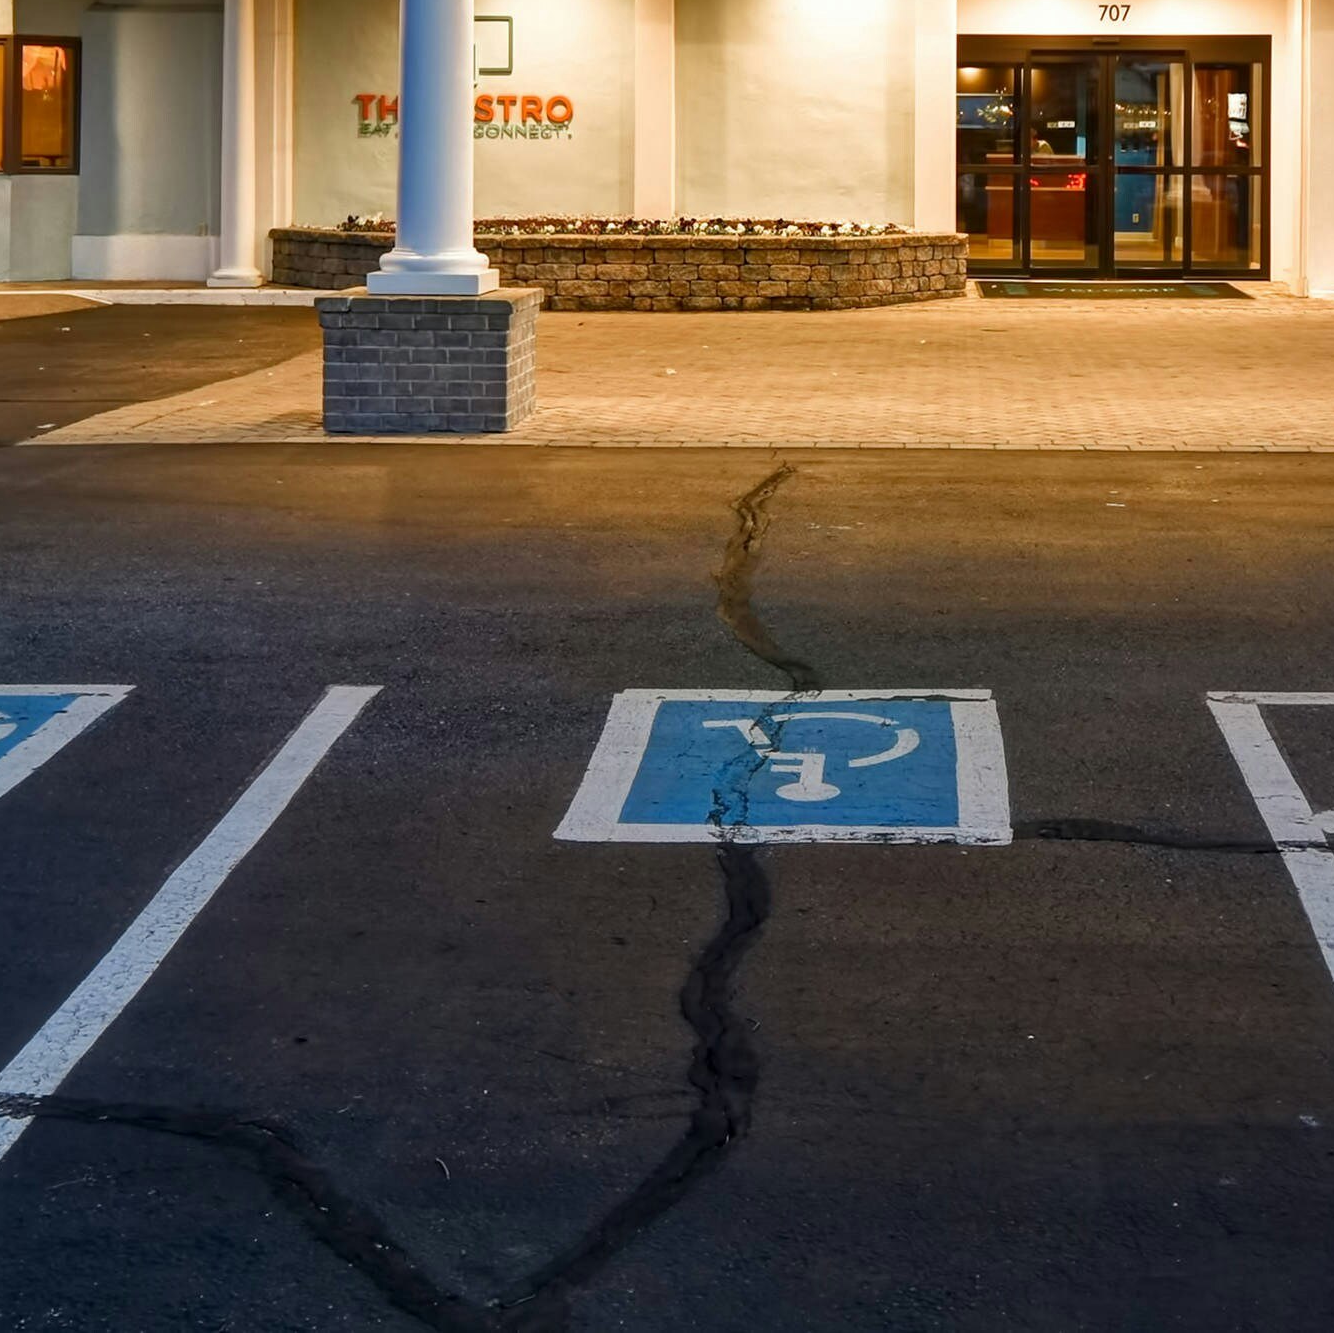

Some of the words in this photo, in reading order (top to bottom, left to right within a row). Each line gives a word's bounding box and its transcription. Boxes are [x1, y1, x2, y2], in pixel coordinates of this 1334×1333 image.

[1098, 4, 1131, 21] 707
[353, 94, 399, 123] TH
[473, 94, 573, 126] STRO
